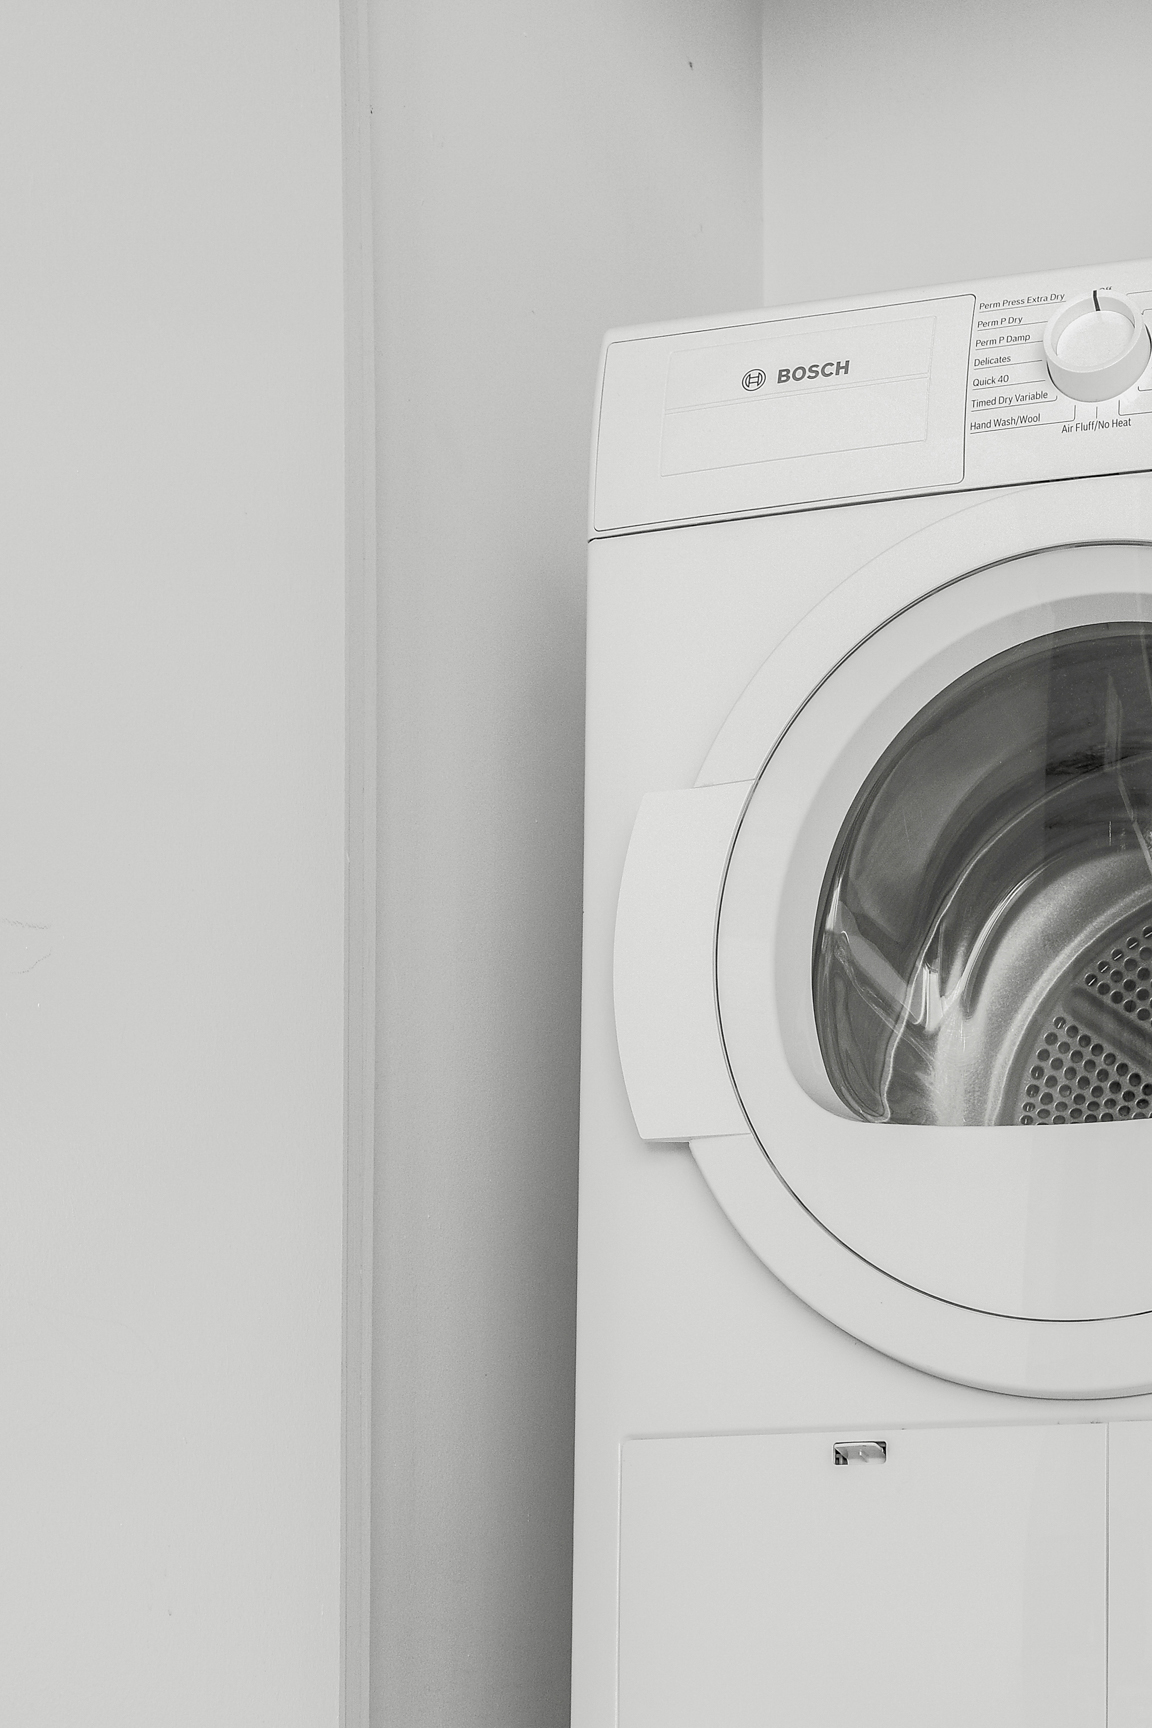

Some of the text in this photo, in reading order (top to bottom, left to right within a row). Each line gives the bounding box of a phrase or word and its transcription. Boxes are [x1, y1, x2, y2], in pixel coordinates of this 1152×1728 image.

[1006, 334, 1030, 342] Damp
[974, 356, 1011, 366] Delicates
[777, 360, 850, 384] BOSCH
[973, 375, 1009, 387] Quick 40
[971, 391, 1048, 408] Timed Dry Variable
[970, 414, 1040, 431] Hand Wash/Wool
[1062, 418, 1132, 433] Air Fluff/No Heat
